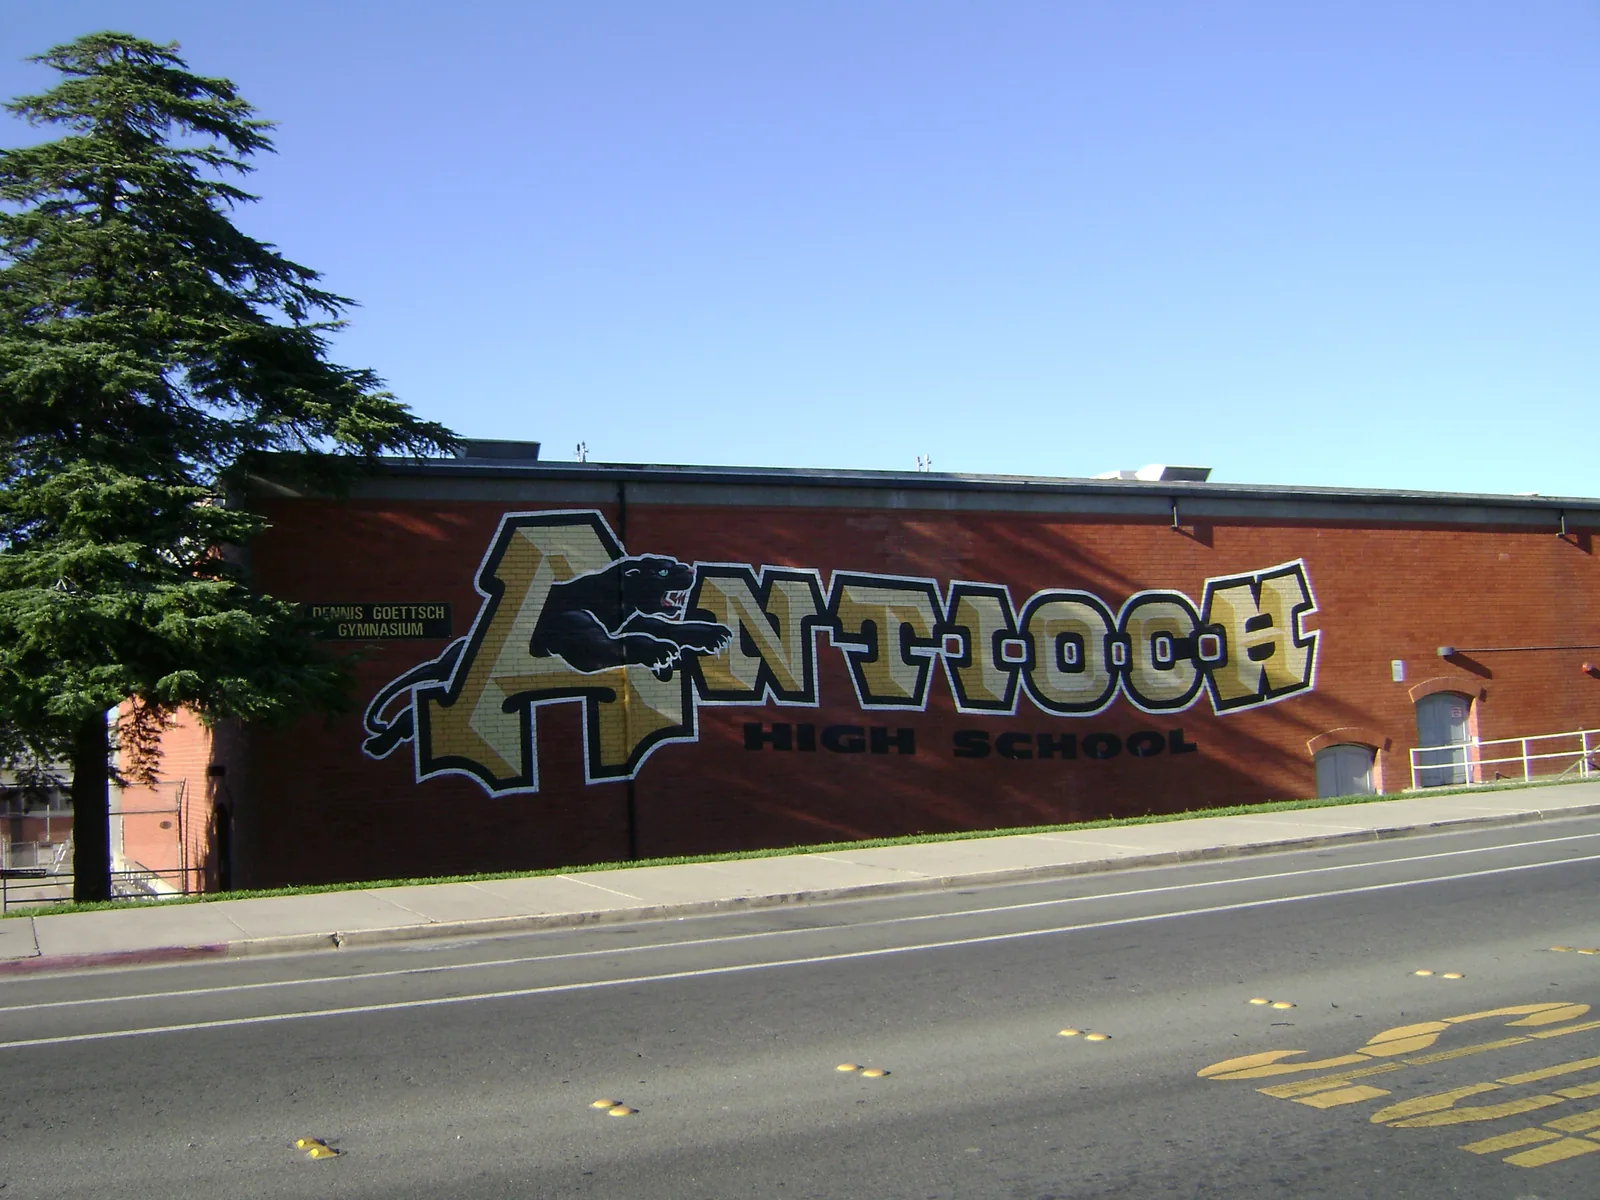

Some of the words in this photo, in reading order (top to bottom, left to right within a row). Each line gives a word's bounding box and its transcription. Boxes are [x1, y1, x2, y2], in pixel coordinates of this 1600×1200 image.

[373, 606, 445, 620] GOETTSCH
[338, 623, 424, 637] GYMNASIUM
[413, 509, 1320, 797] ANTIOCH
[743, 722, 916, 754] HIGH
[953, 728, 1198, 760] SCHOOL
